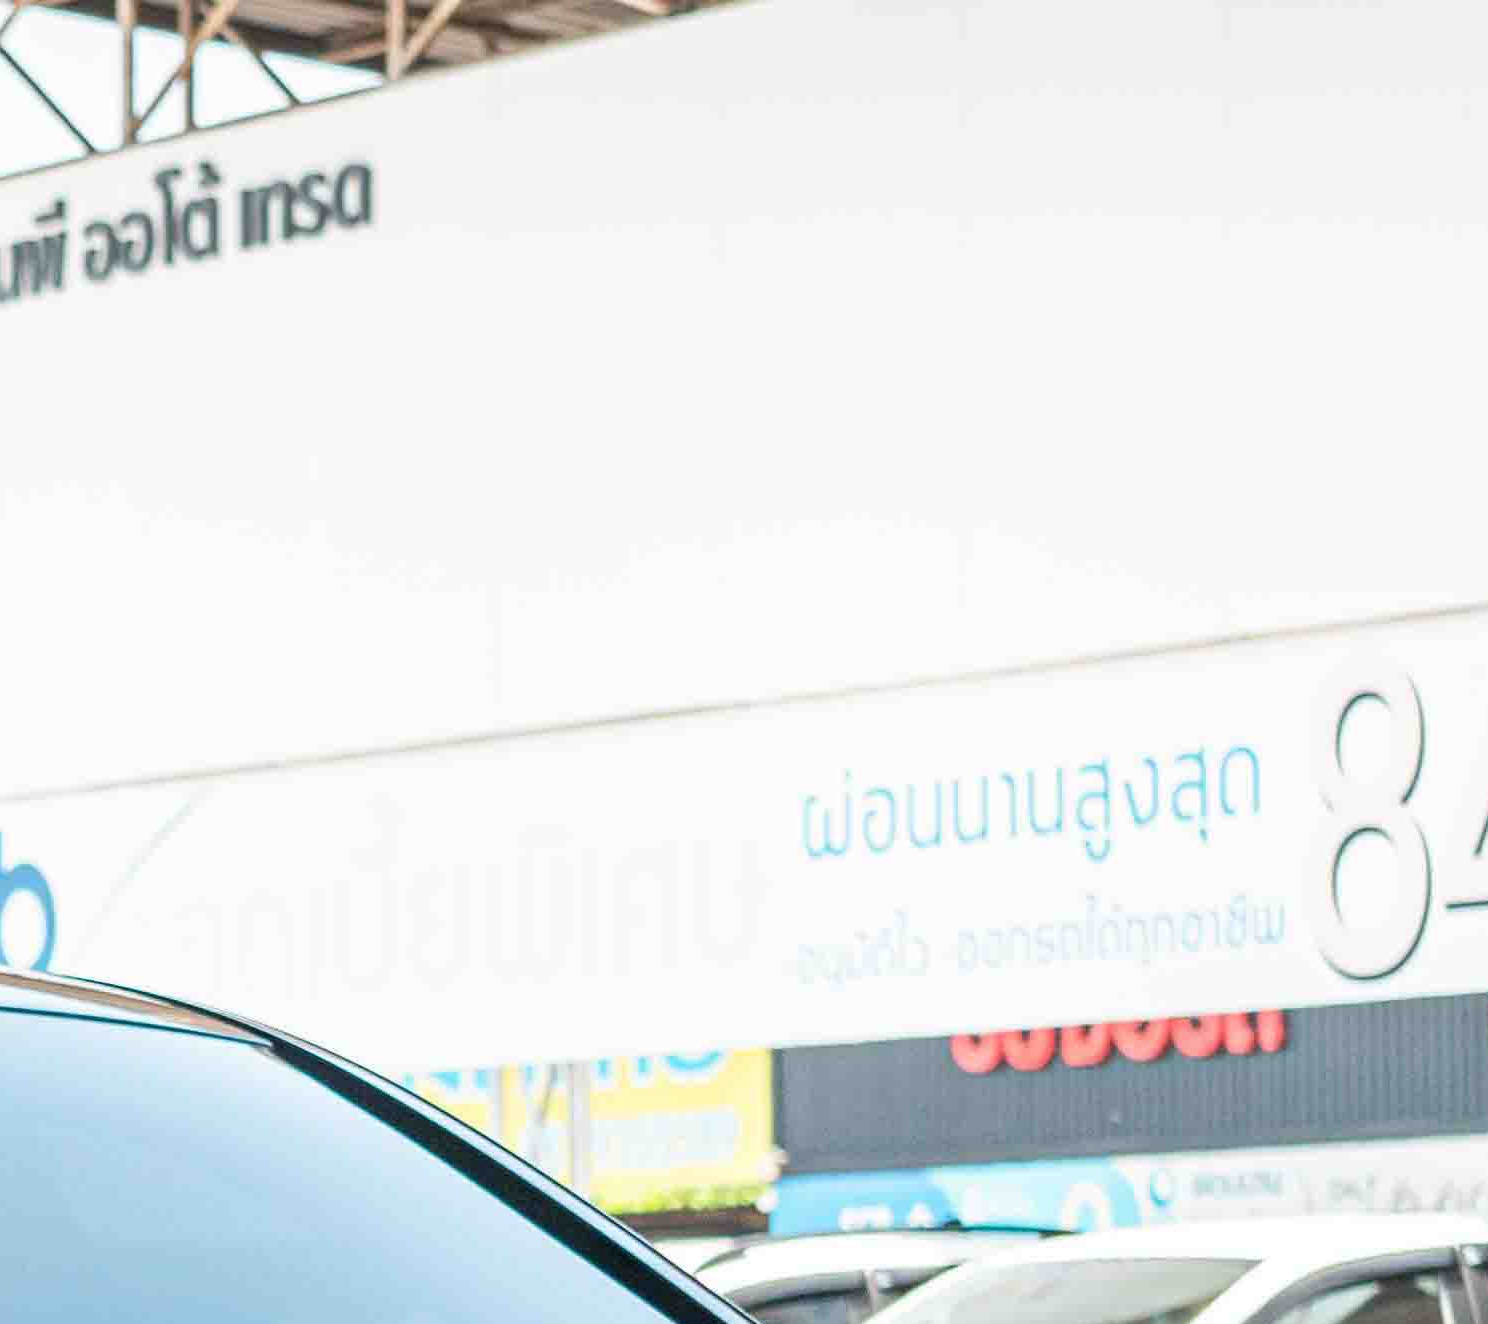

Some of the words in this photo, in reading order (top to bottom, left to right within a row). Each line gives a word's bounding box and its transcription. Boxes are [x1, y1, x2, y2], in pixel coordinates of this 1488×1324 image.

[800, 742, 1262, 863] ผ่อนนานสูงสุด
